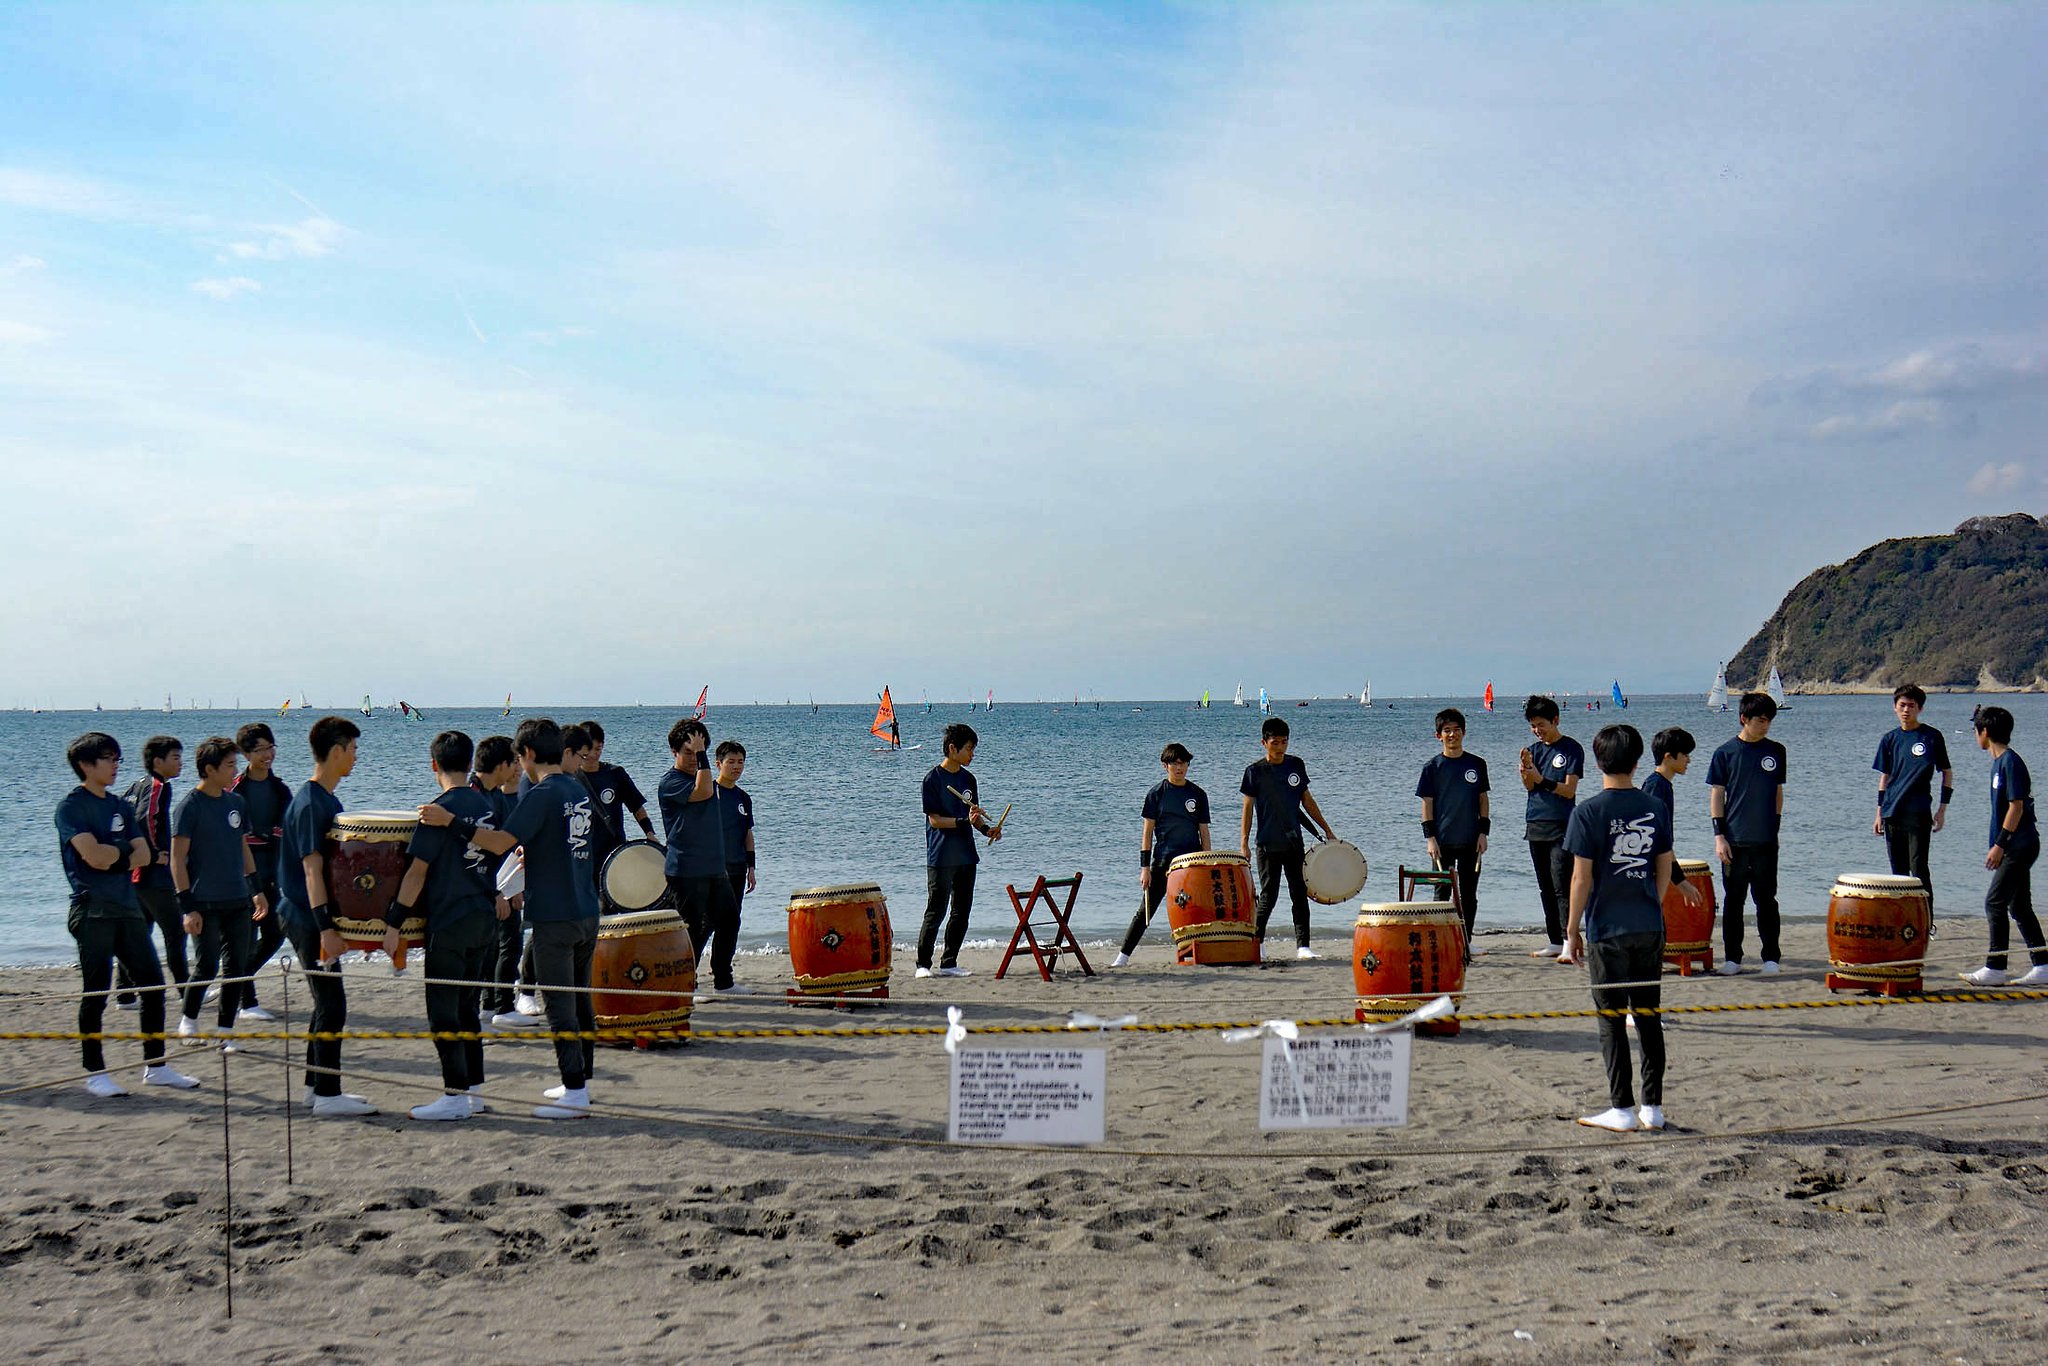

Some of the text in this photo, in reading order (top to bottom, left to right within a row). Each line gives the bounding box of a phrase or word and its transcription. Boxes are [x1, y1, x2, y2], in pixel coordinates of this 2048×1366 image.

[960, 1051, 1083, 1059] From the front row to the
[960, 1061, 984, 1070] third
[1010, 1061, 1040, 1070] Please
[1042, 1061, 1055, 1070] sit
[1058, 1061, 1082, 1070] down
[960, 1071, 977, 1080] and
[984, 1082, 1009, 1091] using
[1012, 1092, 1080, 1101] photographing
[1083, 1091, 1093, 1101] by
[959, 1102, 1079, 1110] standing up and using the
[959, 1112, 1050, 1120] front row chair are
